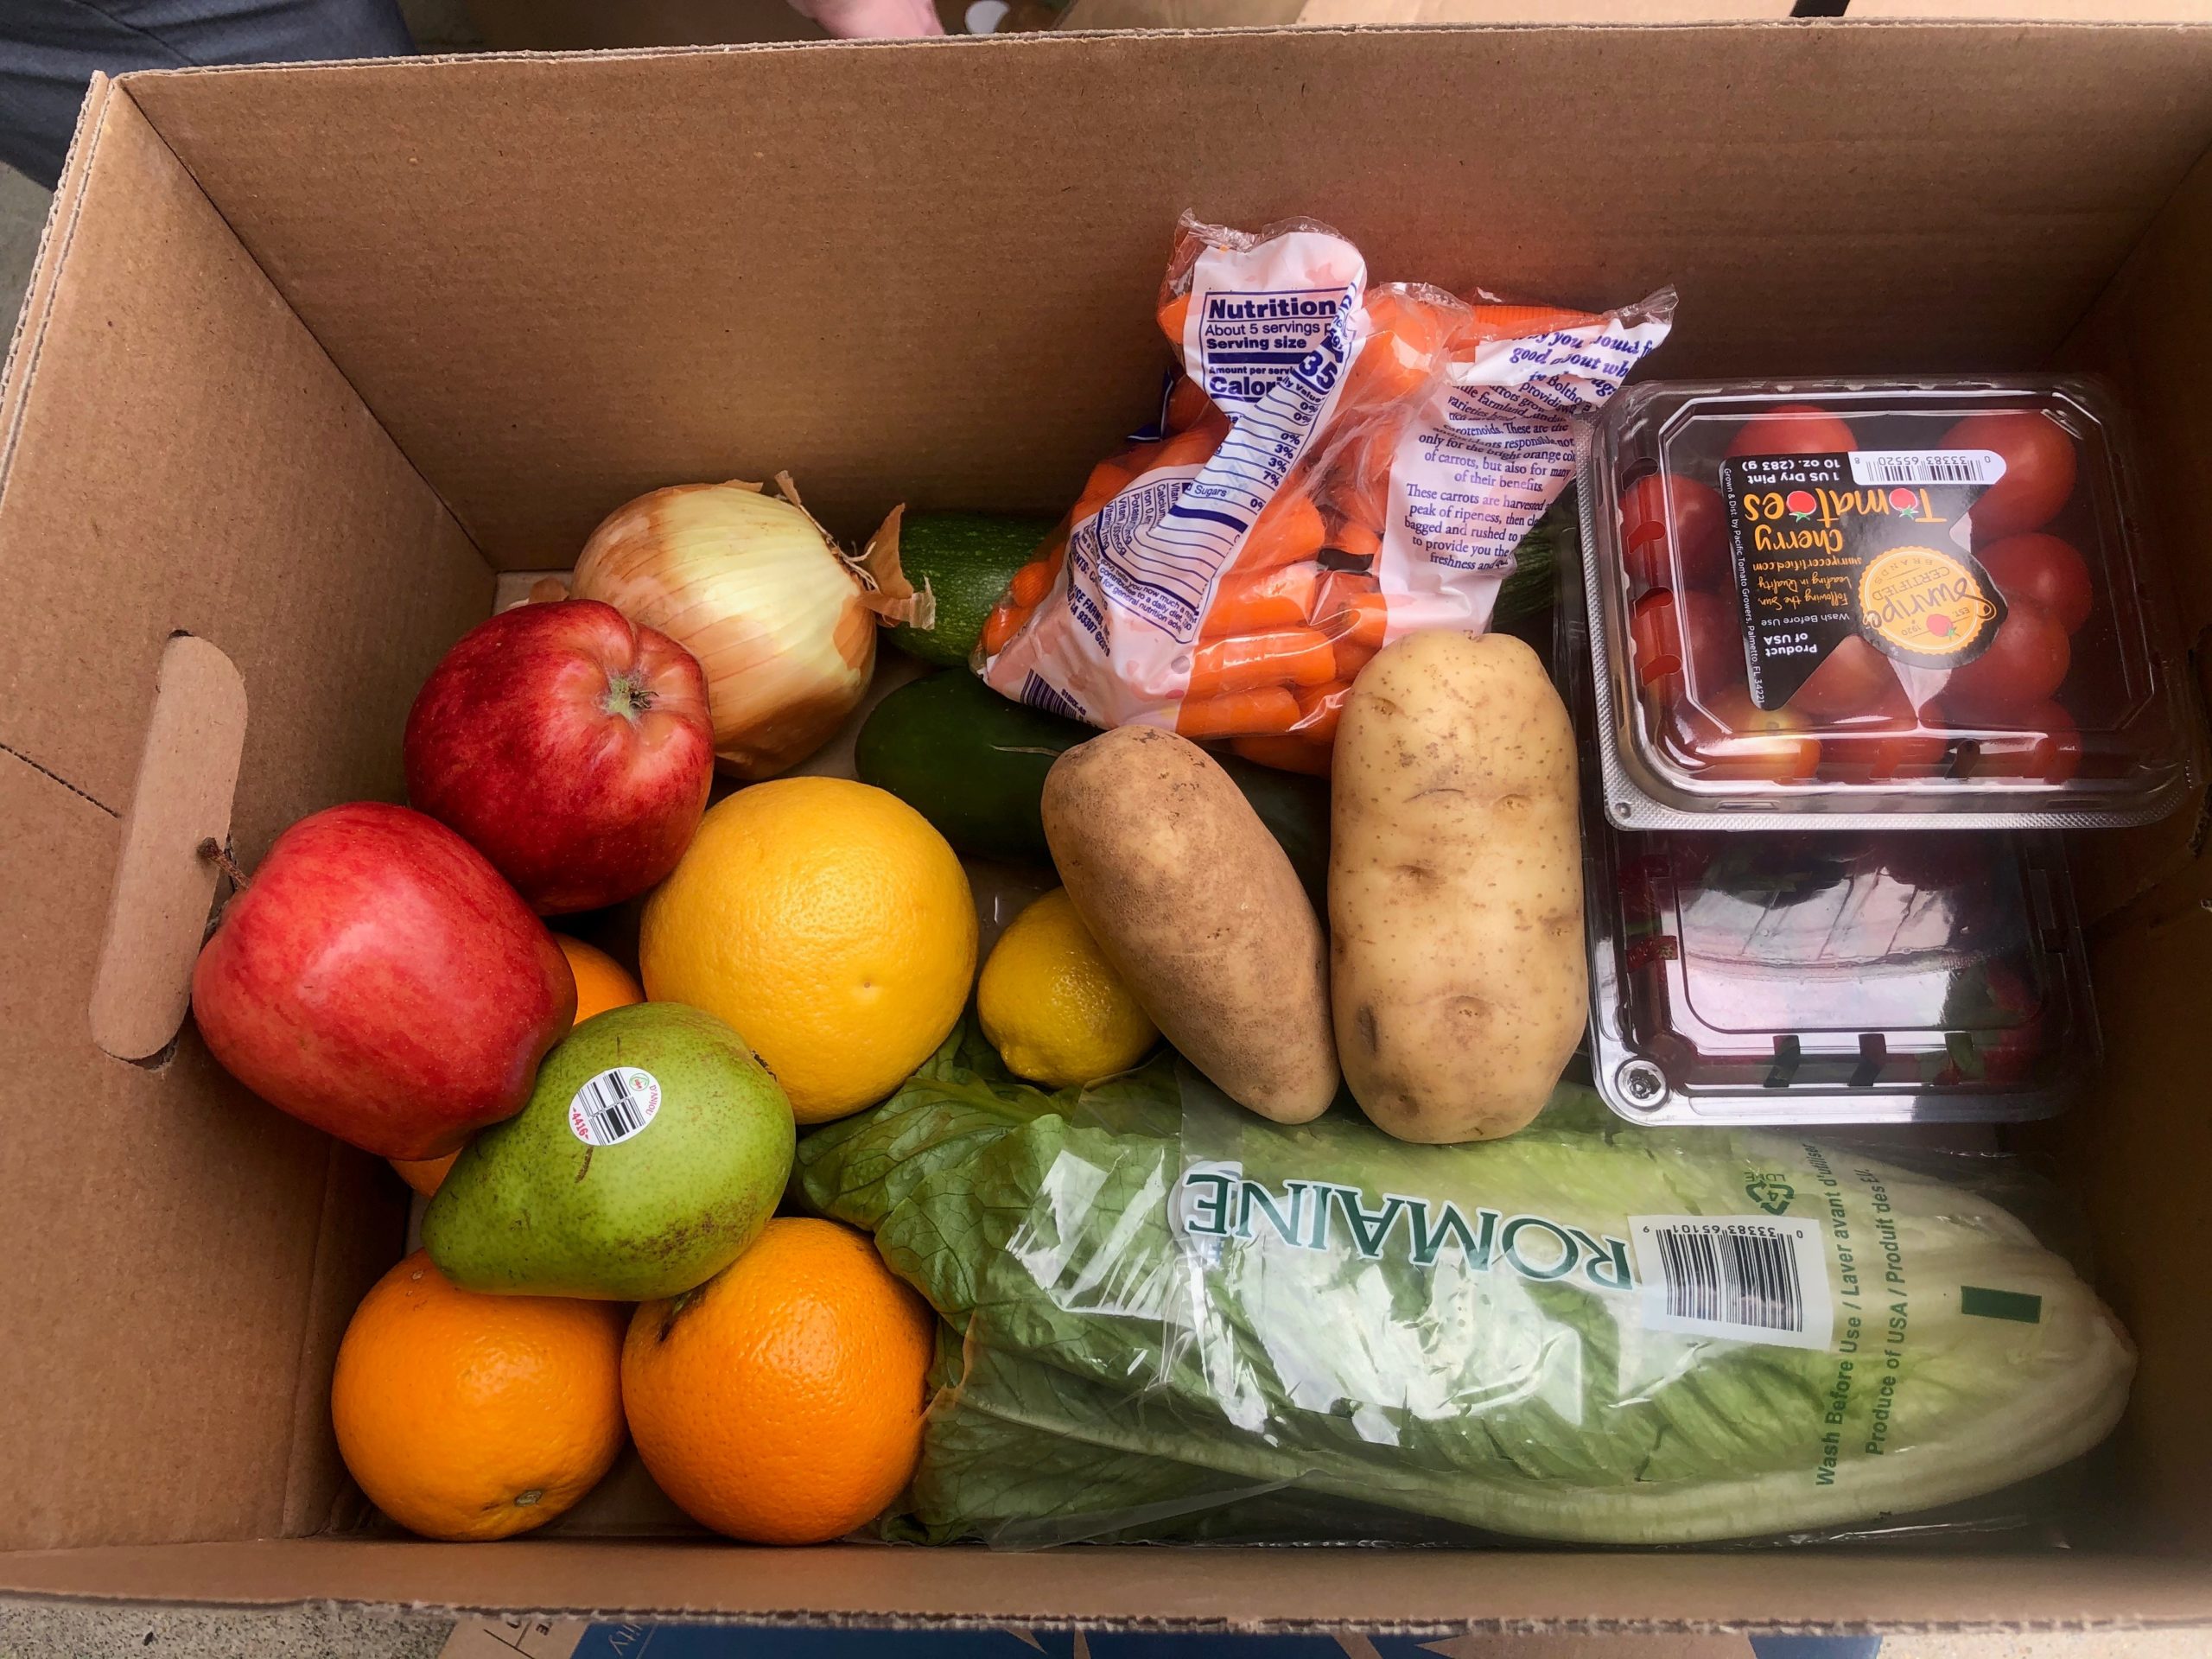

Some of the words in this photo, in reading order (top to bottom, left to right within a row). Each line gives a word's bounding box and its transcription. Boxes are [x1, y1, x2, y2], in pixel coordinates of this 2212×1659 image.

[1208, 297, 1337, 320] Nutrition
[1205, 324, 1246, 336] About
[1249, 323, 1259, 334] 5
[1262, 321, 1321, 336] servings
[1206, 336, 1269, 351] Serving
[1274, 335, 1307, 349] size
[1548, 332, 1585, 349] you
[1510, 347, 1553, 364] good
[1209, 366, 1248, 375] Amount
[1249, 366, 1266, 375] per
[1299, 350, 1338, 391] 35
[1300, 401, 1319, 414] 0%
[1293, 411, 1313, 424] 0%
[1503, 422, 1535, 435] These
[1536, 424, 1548, 434] are
[1550, 423, 1569, 432] the
[1281, 432, 1301, 446] 0%
[1274, 444, 1294, 460] 3%
[1418, 433, 1446, 449] only
[1446, 436, 1463, 449] for
[1465, 443, 1484, 454] the
[1485, 448, 1522, 461] bright
[1522, 449, 1562, 465] orange
[1268, 457, 1287, 474] 3%
[1424, 448, 1440, 462] of
[1438, 452, 1479, 469] carrots,
[1482, 455, 1502, 472] but
[1504, 460, 1527, 475] also
[1529, 461, 1548, 476] for
[1550, 467, 1572, 481] many
[1742, 461, 1758, 472] g)
[1762, 460, 1795, 471] (283
[1798, 459, 1820, 467] oz.
[1823, 460, 1841, 468] 10
[1878, 456, 1920, 467] 65520
[1926, 456, 1967, 466] 33383
[1984, 455, 1992, 464] 0
[1263, 470, 1280, 487] 7%
[1454, 470, 1470, 482] of
[1470, 472, 1497, 487] their
[1499, 475, 1544, 493] benefits.
[1724, 467, 1733, 493] Grown
[1747, 474, 1777, 484] Pint
[1780, 472, 1806, 482] Dry
[1809, 472, 1830, 481] US
[1832, 472, 1840, 480] 1
[1144, 488, 1153, 508] Iron
[1194, 485, 1228, 498] Sugars
[1406, 483, 1438, 500] These
[1440, 491, 1480, 504] carrots
[1482, 496, 1501, 507] are
[1502, 495, 1547, 512] harvested
[1156, 483, 1166, 521] Calcium
[1729, 500, 1738, 517] Dist.
[1408, 504, 1437, 518] peak
[1439, 505, 1454, 518] of
[1454, 507, 1503, 524] ripeness,
[1505, 514, 1525, 527] then
[1731, 518, 1739, 529] by
[1404, 516, 1442, 537] bagged
[1445, 523, 1468, 537] and
[1471, 528, 1506, 542] rushed
[1508, 532, 1518, 543] to
[1412, 536, 1423, 546] to
[1425, 538, 1470, 552] provide
[1471, 545, 1491, 557] you
[1494, 544, 1510, 557] the
[1733, 530, 1745, 556] Pacific
[1754, 524, 1844, 555] Cherry
[1430, 552, 1477, 571] freshness
[1477, 561, 1495, 571] and
[1738, 557, 1747, 587] Tomato
[1812, 571, 1853, 589] Leading
[1099, 566, 1137, 596] contributes
[1136, 592, 1146, 601] to
[1151, 598, 1170, 615] daily
[1758, 575, 1799, 594] Quality
[1872, 566, 1950, 601] CERTIFIED
[1102, 577, 1116, 589] for
[1112, 585, 1138, 607] general
[1138, 601, 1168, 623] nutrition
[1128, 580, 1143, 593] you
[1143, 586, 1160, 598] how
[1159, 594, 1179, 611] much
[1784, 597, 1802, 610] the
[1804, 588, 1848, 607] Following
[1741, 588, 1752, 624] Growers,
[1077, 610, 1098, 634] 93307
[1761, 619, 1781, 627] Use
[1783, 614, 1818, 624] Before
[1821, 613, 1850, 622] Wash
[1747, 625, 1758, 664] Palmetto,
[1763, 634, 1792, 645] USA
[1794, 632, 1808, 643] of
[1765, 644, 1818, 657] Product
[1752, 665, 1761, 677] FL
[1754, 678, 1765, 703] 34221
[1871, 1185, 1891, 1214] des
[1824, 1191, 1850, 1241] avant
[1185, 1173, 1633, 1291] ROMAINE
[1643, 1225, 1650, 1234] 9
[1672, 1224, 1720, 1234] 65101
[1727, 1224, 1777, 1238] 33383
[1796, 1230, 1804, 1239] 0
[1876, 1217, 1904, 1283] Produit
[1837, 1243, 1860, 1297] Laver
[1887, 1302, 1909, 1344] USA
[1839, 1316, 1862, 1354] Use
[1885, 1349, 1901, 1370] of
[1824, 1360, 1853, 1425] Before
[1865, 1375, 1897, 1455] Produce
[1815, 1431, 1840, 1486] Wash
